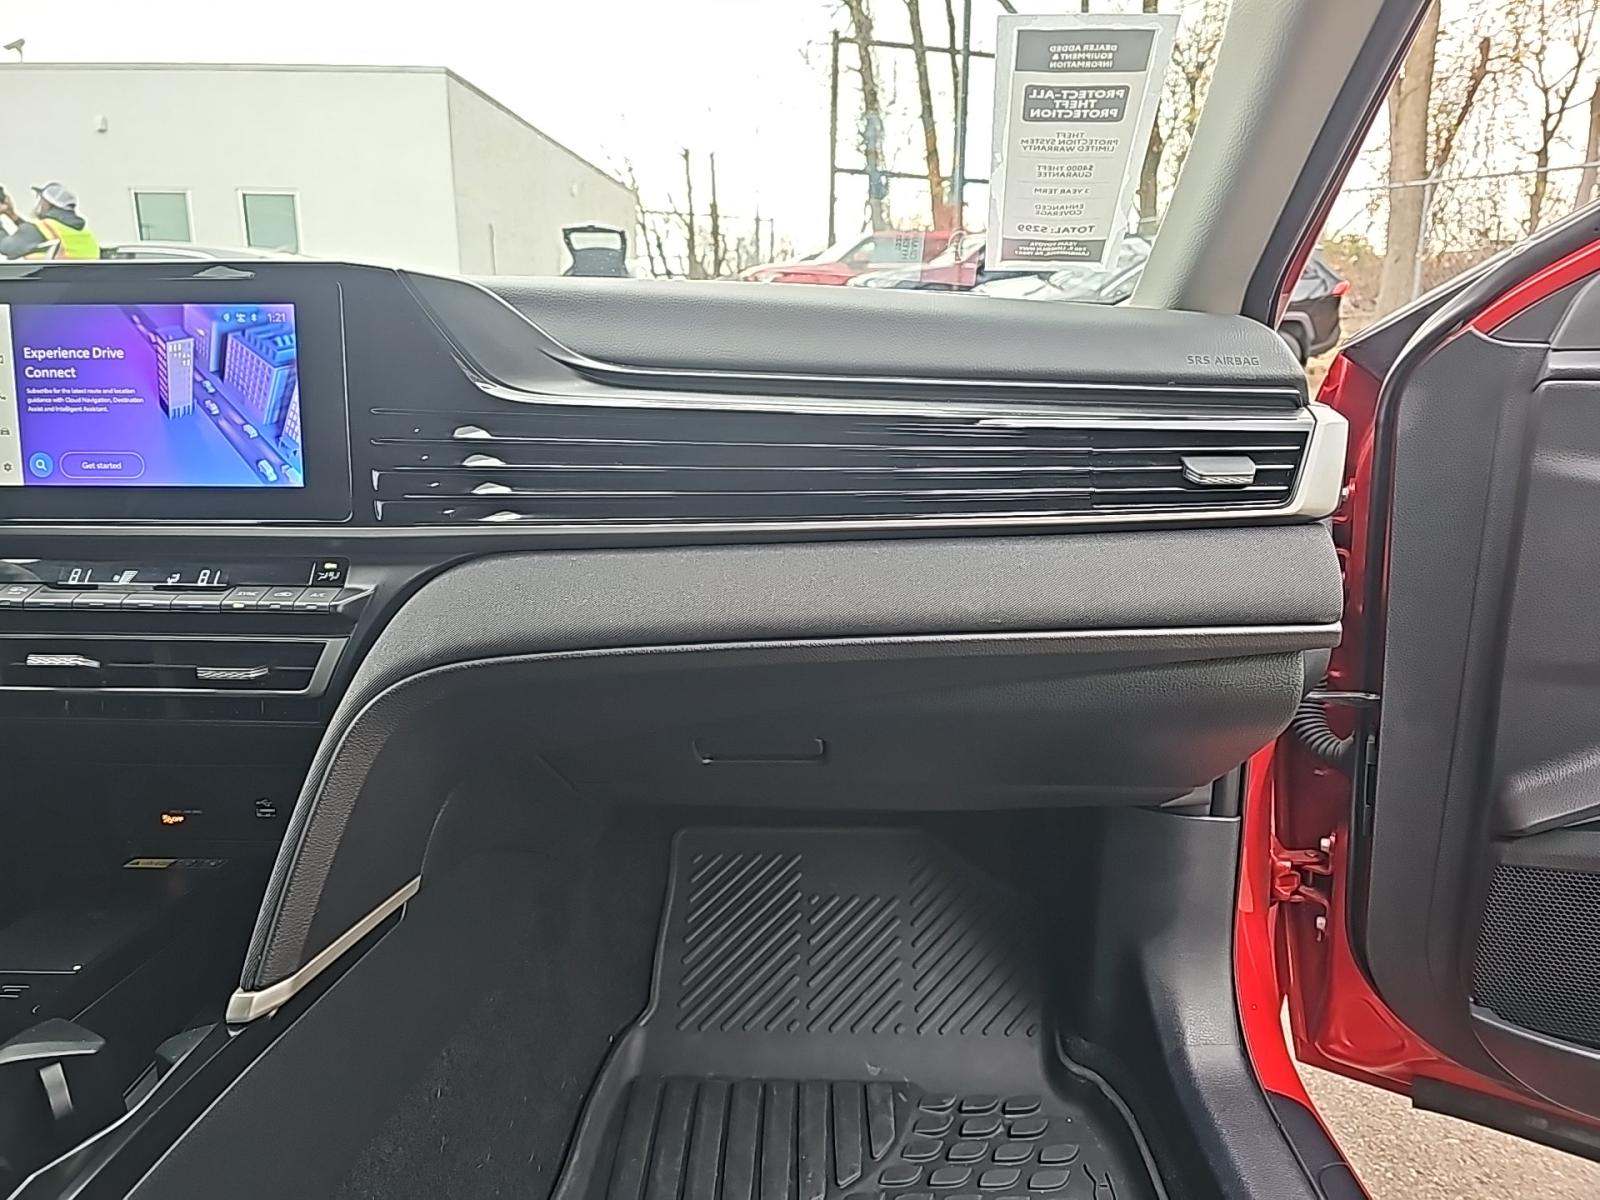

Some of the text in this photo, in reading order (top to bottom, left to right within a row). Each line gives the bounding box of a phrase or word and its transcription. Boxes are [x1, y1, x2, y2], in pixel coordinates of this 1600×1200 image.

[267, 312, 286, 323] 1:21
[23, 347, 124, 361] Experience Drive
[1187, 355, 1260, 366] SRS AIRBAG
[25, 366, 76, 378] Connect
[81, 461, 122, 470] Get started
[67, 568, 93, 584] 81
[198, 569, 222, 585] 81
